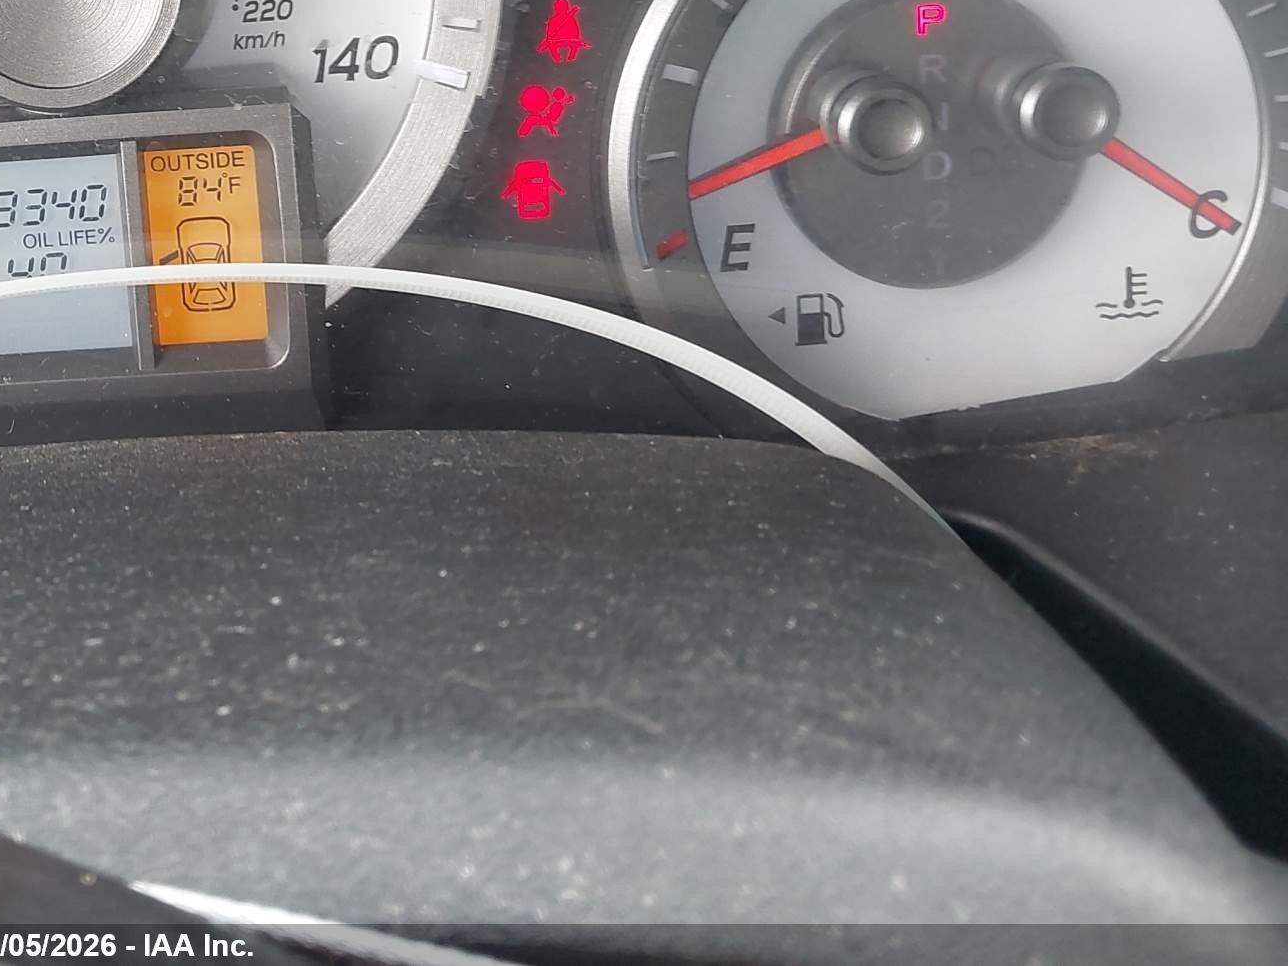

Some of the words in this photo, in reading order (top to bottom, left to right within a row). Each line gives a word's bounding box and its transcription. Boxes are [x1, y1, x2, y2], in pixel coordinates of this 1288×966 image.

[242, 0, 293, 24] 220
[916, 3, 946, 36] P
[232, 30, 286, 53] km/h
[312, 34, 400, 84] 140
[151, 151, 245, 172] OUTSIDE
[1188, 190, 1229, 239] C
[23, 232, 53, 249] OIL
[720, 223, 755, 272] E
